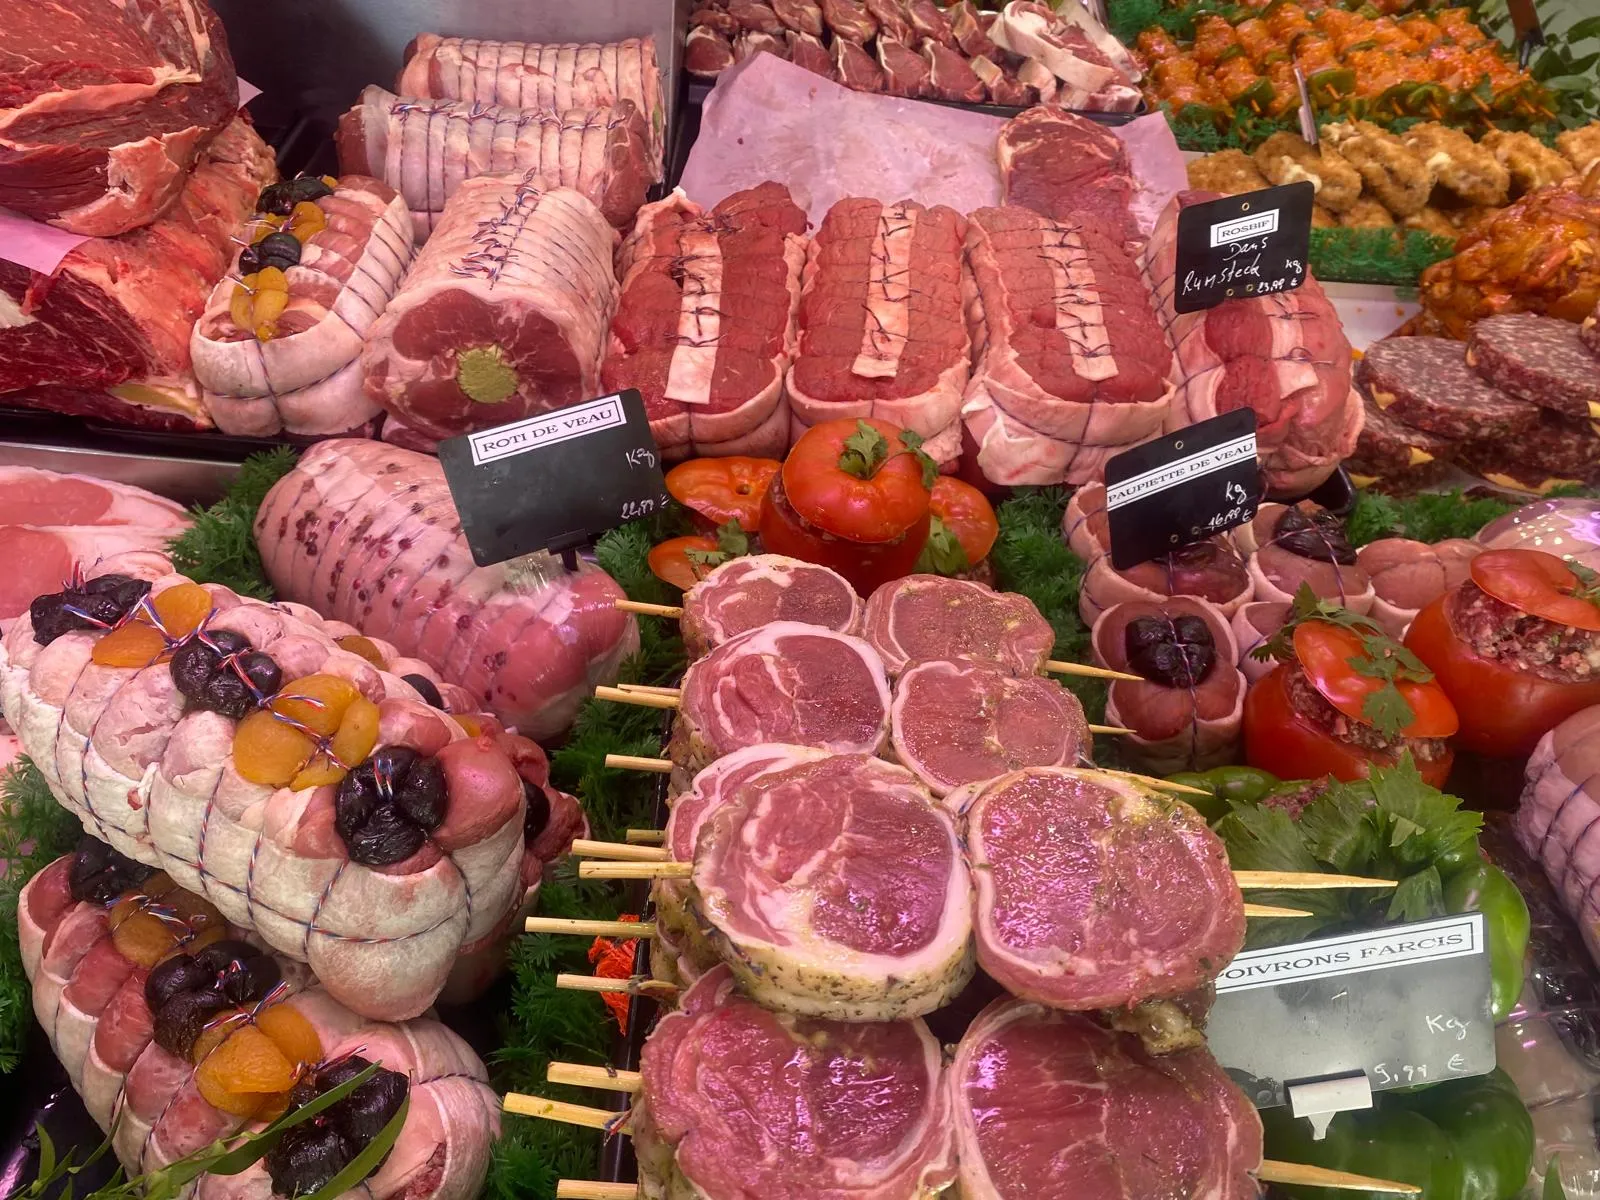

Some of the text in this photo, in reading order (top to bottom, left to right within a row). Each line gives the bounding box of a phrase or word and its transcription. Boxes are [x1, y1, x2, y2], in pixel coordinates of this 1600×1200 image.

[1221, 219, 1270, 238] ROSBIF
[1222, 236, 1269, 261] Dans
[482, 408, 613, 453] ROTI DE VEAU
[1107, 442, 1254, 503] PAUPIETTE DE VEAU
[620, 499, 654, 520] 22,99
[1218, 932, 1464, 979] OIVRONS FARCIS
[1425, 1014, 1471, 1041] Kg
